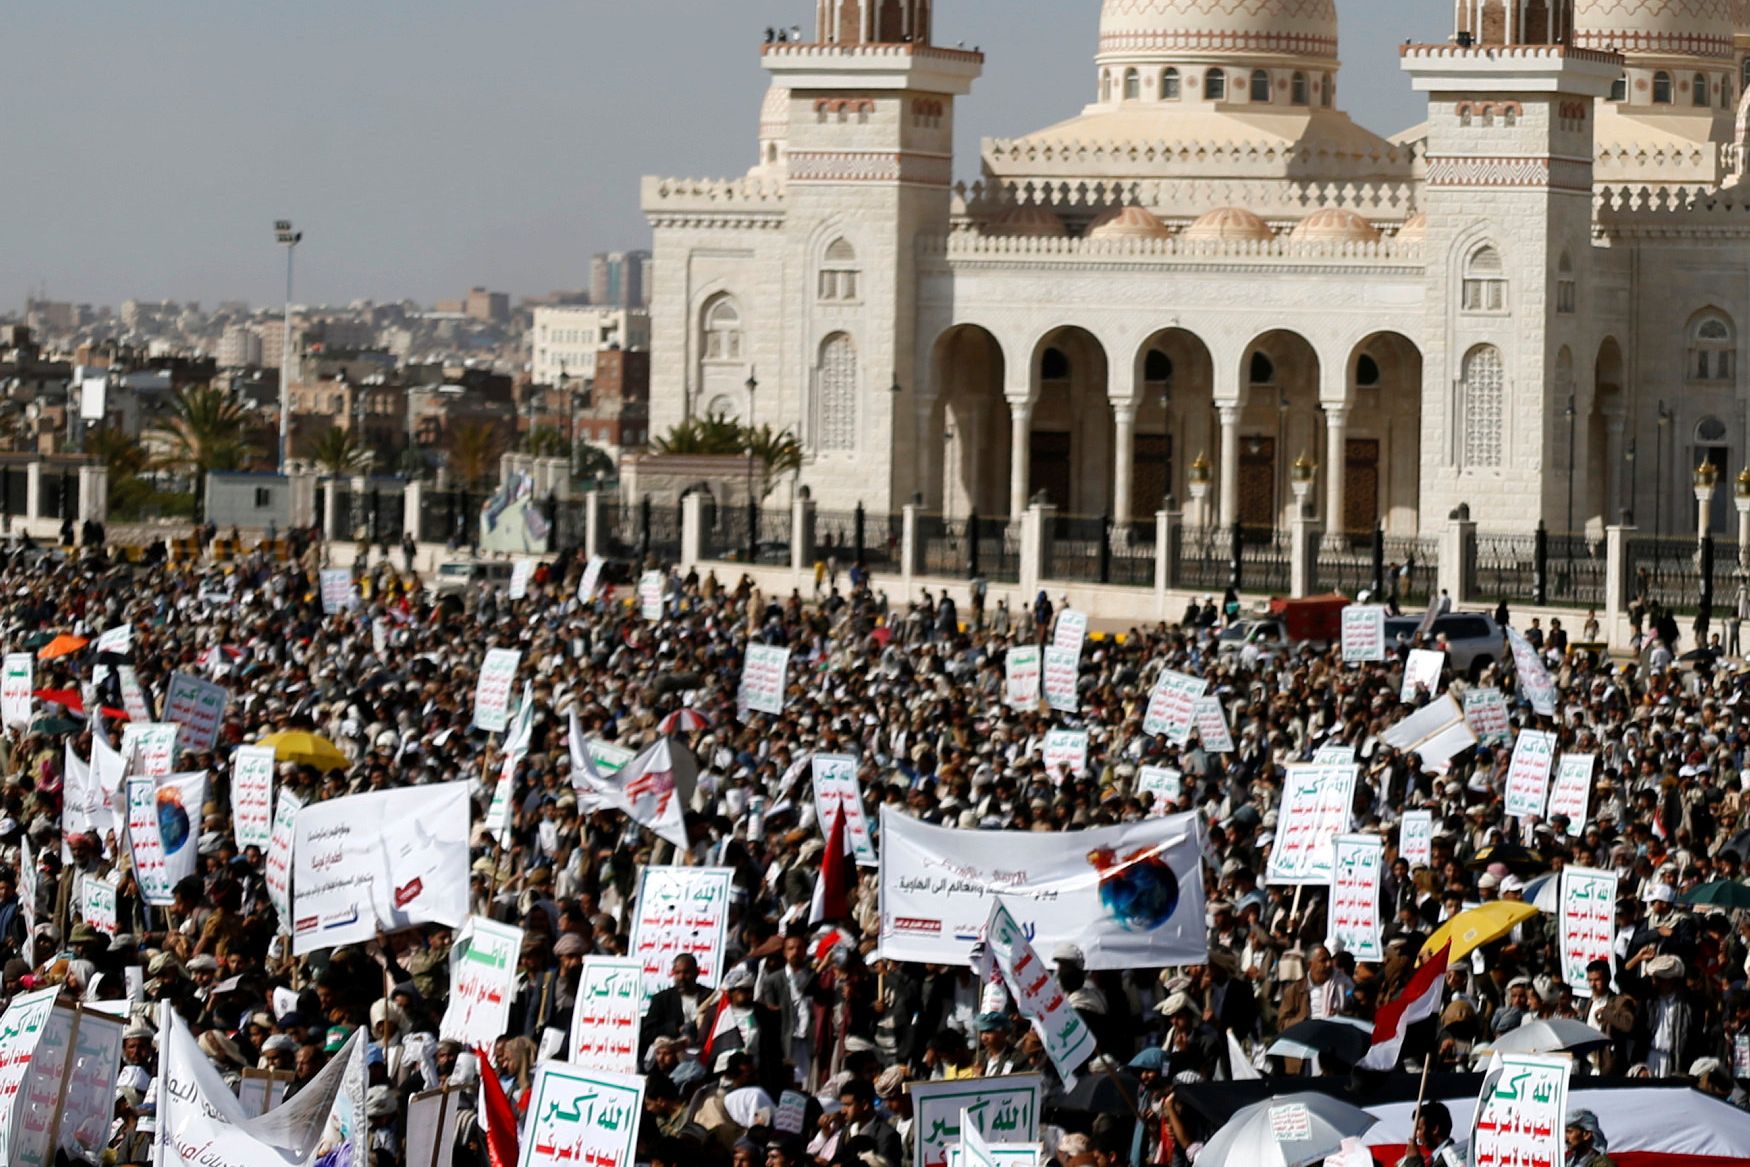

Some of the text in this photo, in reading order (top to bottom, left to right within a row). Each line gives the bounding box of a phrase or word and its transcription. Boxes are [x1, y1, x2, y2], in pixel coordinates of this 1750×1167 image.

[585, 968, 639, 1004] الله أكبر
[612, 1011, 637, 1030] الموت
[609, 1038, 636, 1058] الموت
[168, 1069, 199, 1106] اليم
[1480, 1065, 1559, 1109] الله أكبر
[541, 1086, 633, 1133] الله أكبر
[991, 1097, 1029, 1132] الله
[1522, 1117, 1557, 1141] الموت
